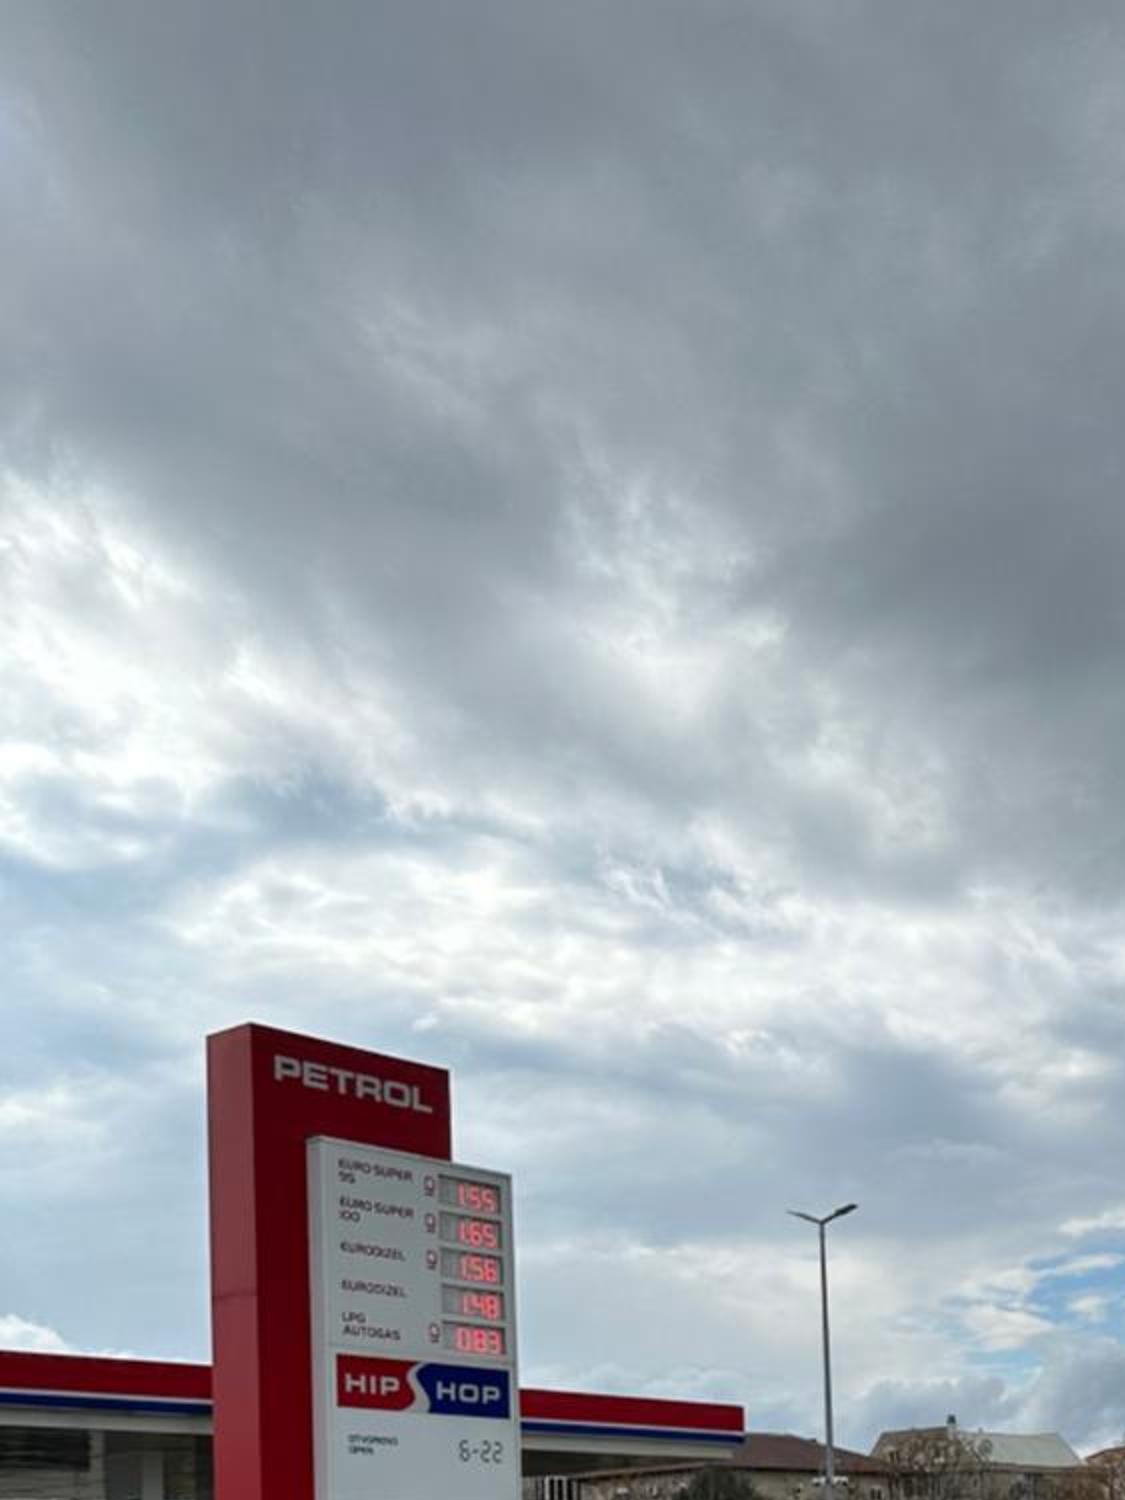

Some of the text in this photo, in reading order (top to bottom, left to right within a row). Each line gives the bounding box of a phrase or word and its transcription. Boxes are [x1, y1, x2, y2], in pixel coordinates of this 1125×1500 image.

[273, 1055, 433, 1113] PETROL
[338, 1158, 413, 1182] EURO SUPER
[339, 1195, 414, 1218] EURO SUPER
[341, 1311, 367, 1324] LPG
[342, 1324, 401, 1341] AUTOGAS
[344, 1373, 501, 1405] HIP HOP
[459, 1439, 502, 1463] 6-22
